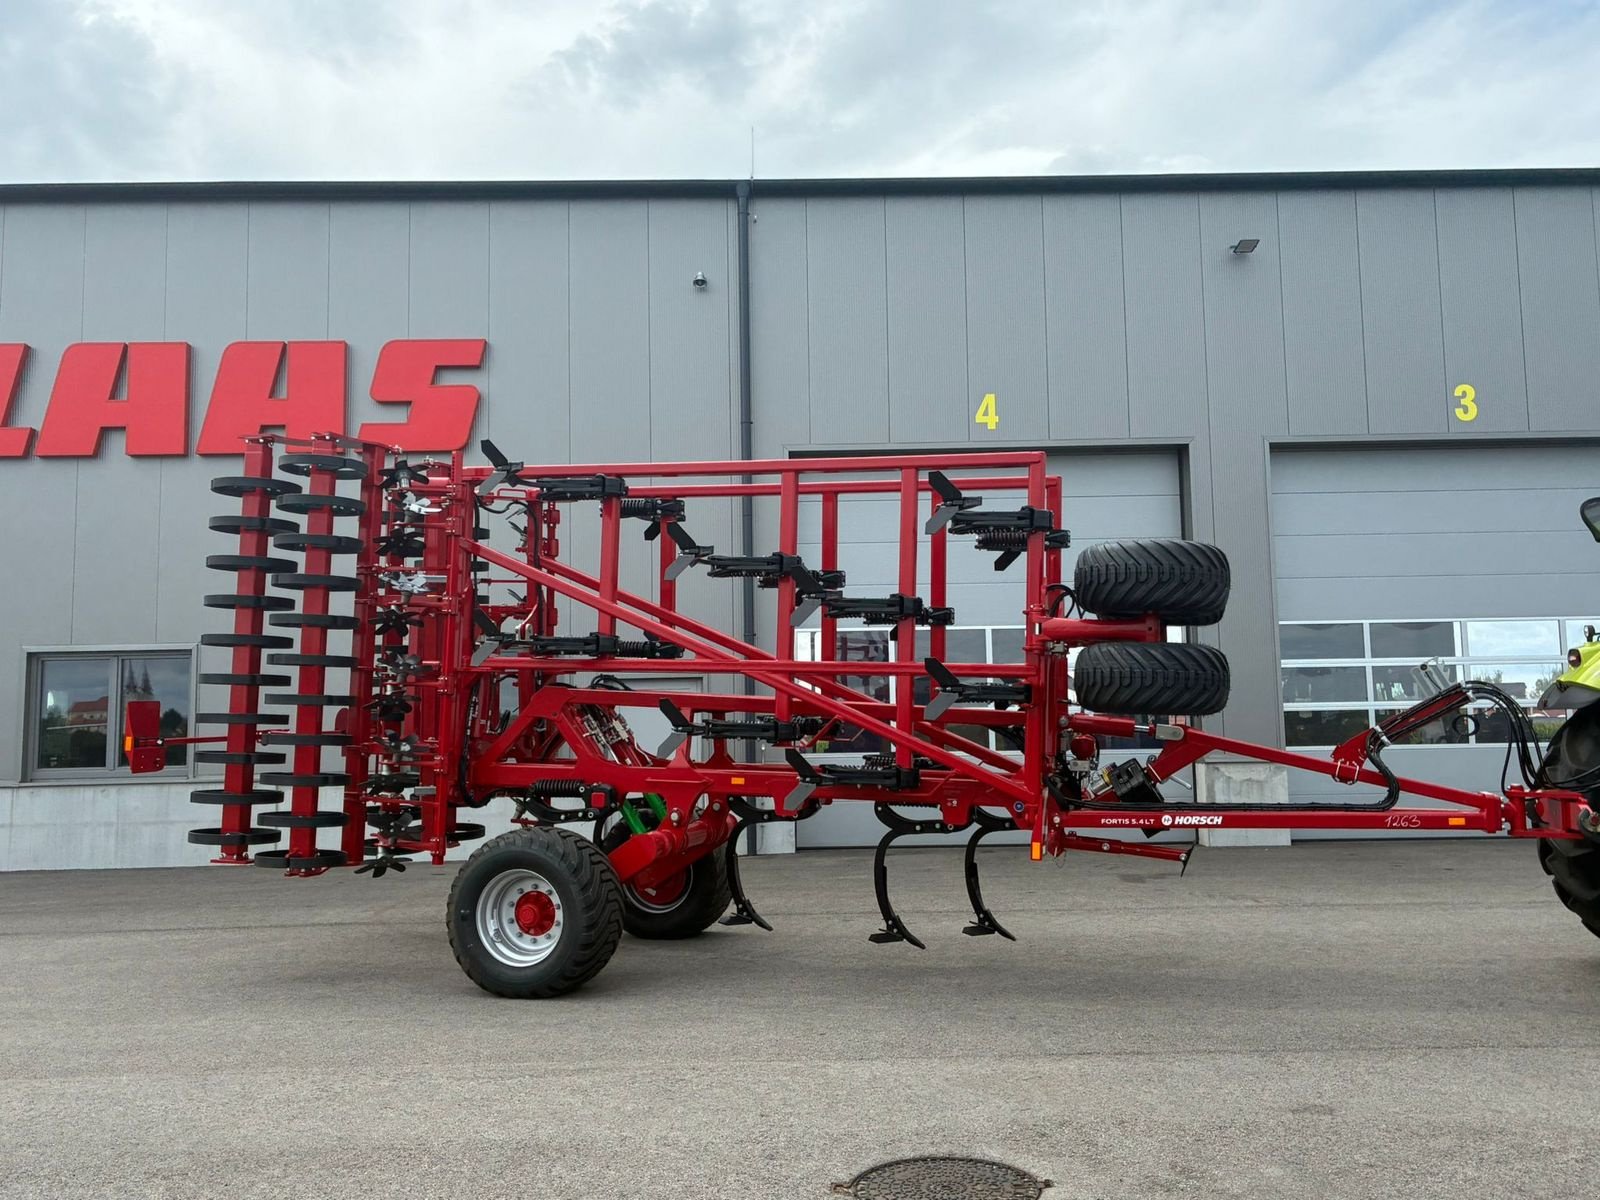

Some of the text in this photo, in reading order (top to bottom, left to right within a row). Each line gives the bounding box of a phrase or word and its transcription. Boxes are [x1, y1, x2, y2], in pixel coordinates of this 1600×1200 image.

[975, 394, 999, 429] 4
[1454, 384, 1477, 421] 3
[1174, 815, 1223, 825] HORSCH
[1384, 814, 1421, 828] 1263
